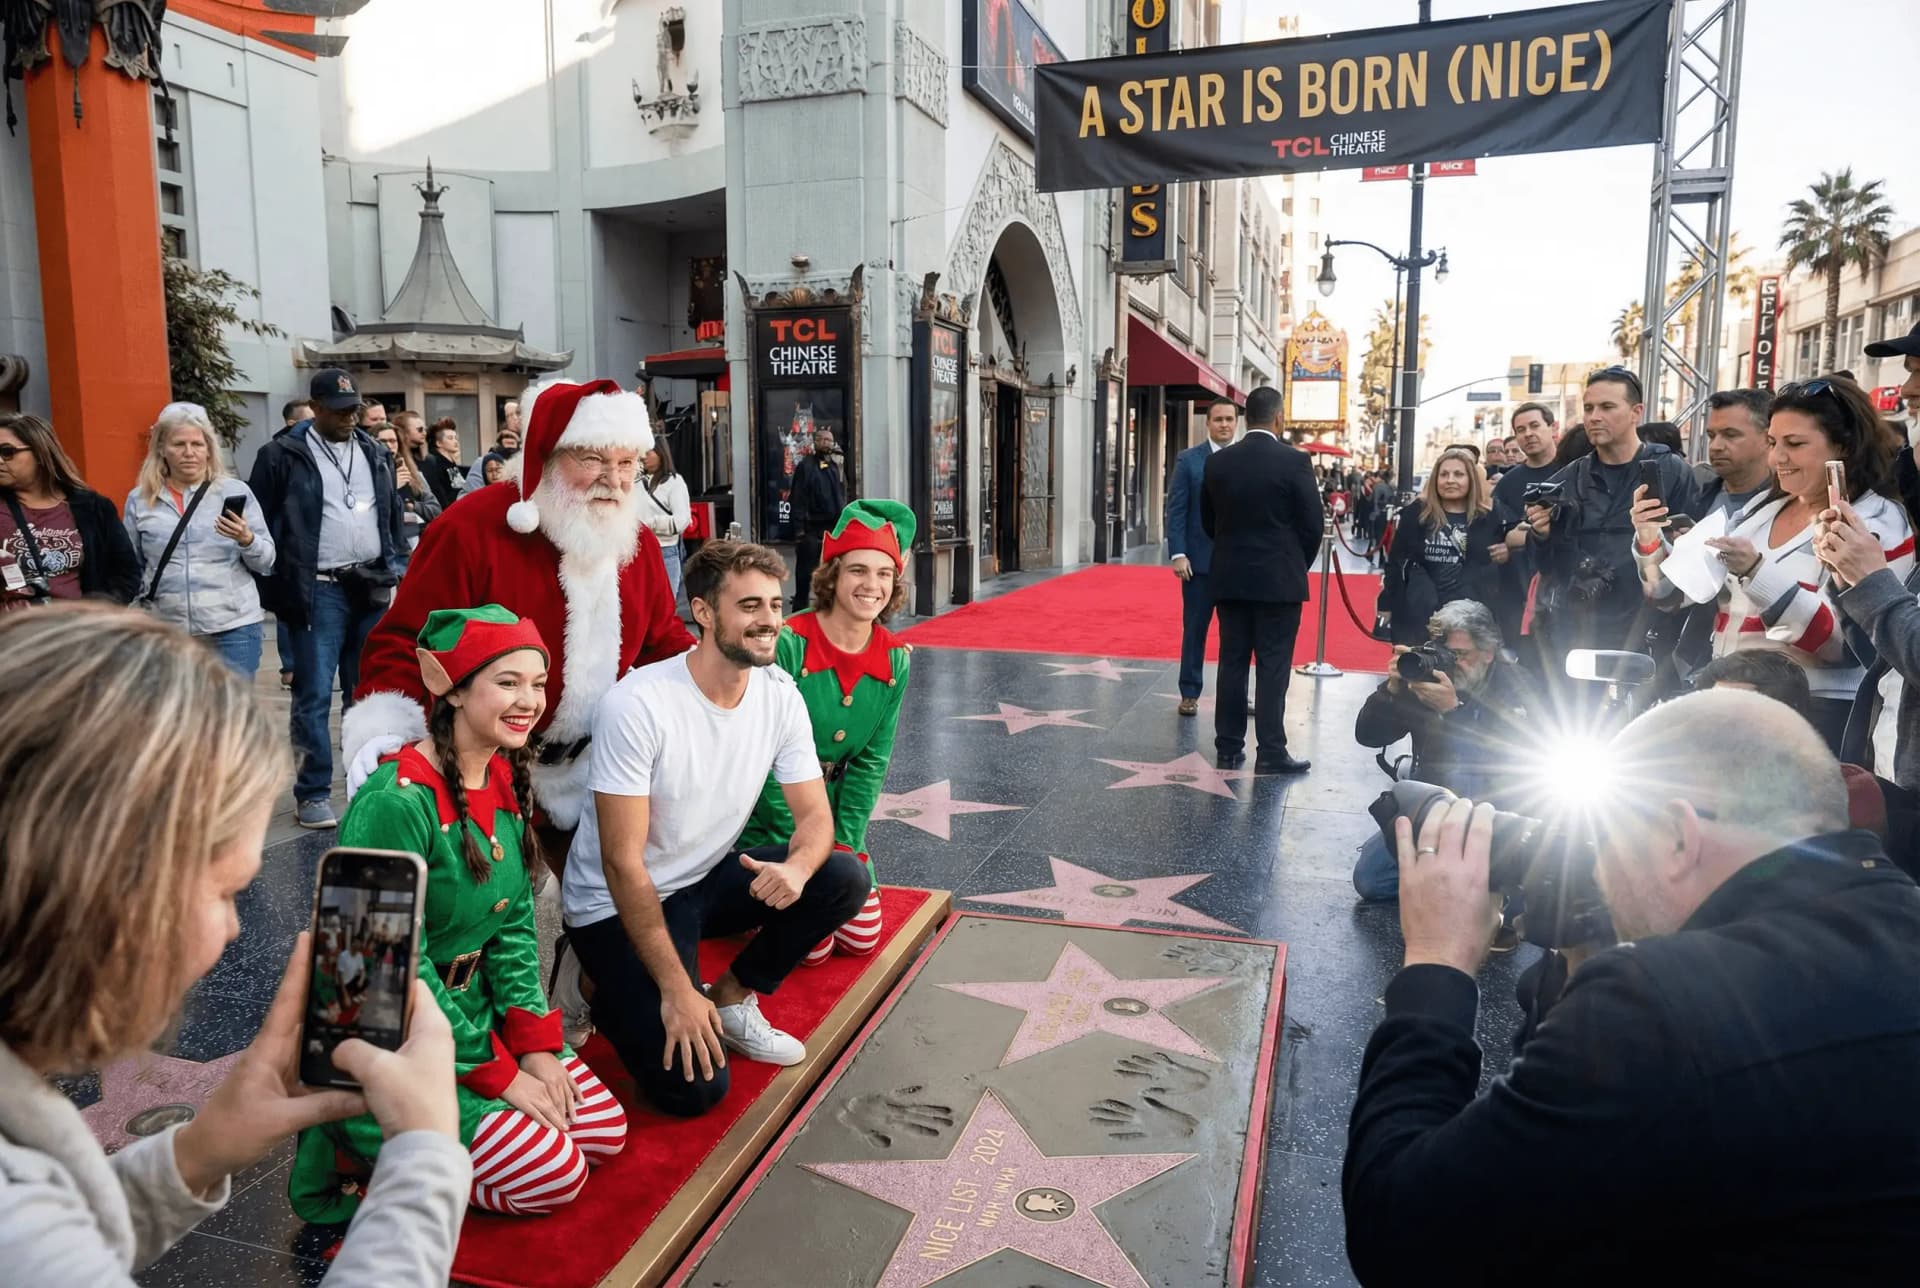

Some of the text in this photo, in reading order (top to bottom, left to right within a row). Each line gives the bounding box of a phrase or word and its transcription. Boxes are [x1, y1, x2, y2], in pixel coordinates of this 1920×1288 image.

[1078, 85, 1106, 138] A
[1119, 72, 1226, 135] STAR
[1242, 65, 1283, 125] IS
[1299, 50, 1428, 119] BORN
[1447, 28, 1613, 105] (NICE)
[1271, 136, 1330, 159] TCL
[1330, 129, 1386, 146] CHINESE
[1330, 141, 1386, 157] THEATRE
[769, 318, 837, 343] TCL
[932, 328, 958, 354] TCL
[769, 345, 837, 361] CHINESE
[770, 360, 838, 376] THEATRE
[919, 1217, 966, 1262] NICE
[944, 1177, 982, 1214] LIST
[969, 1127, 1006, 1166] 2024
